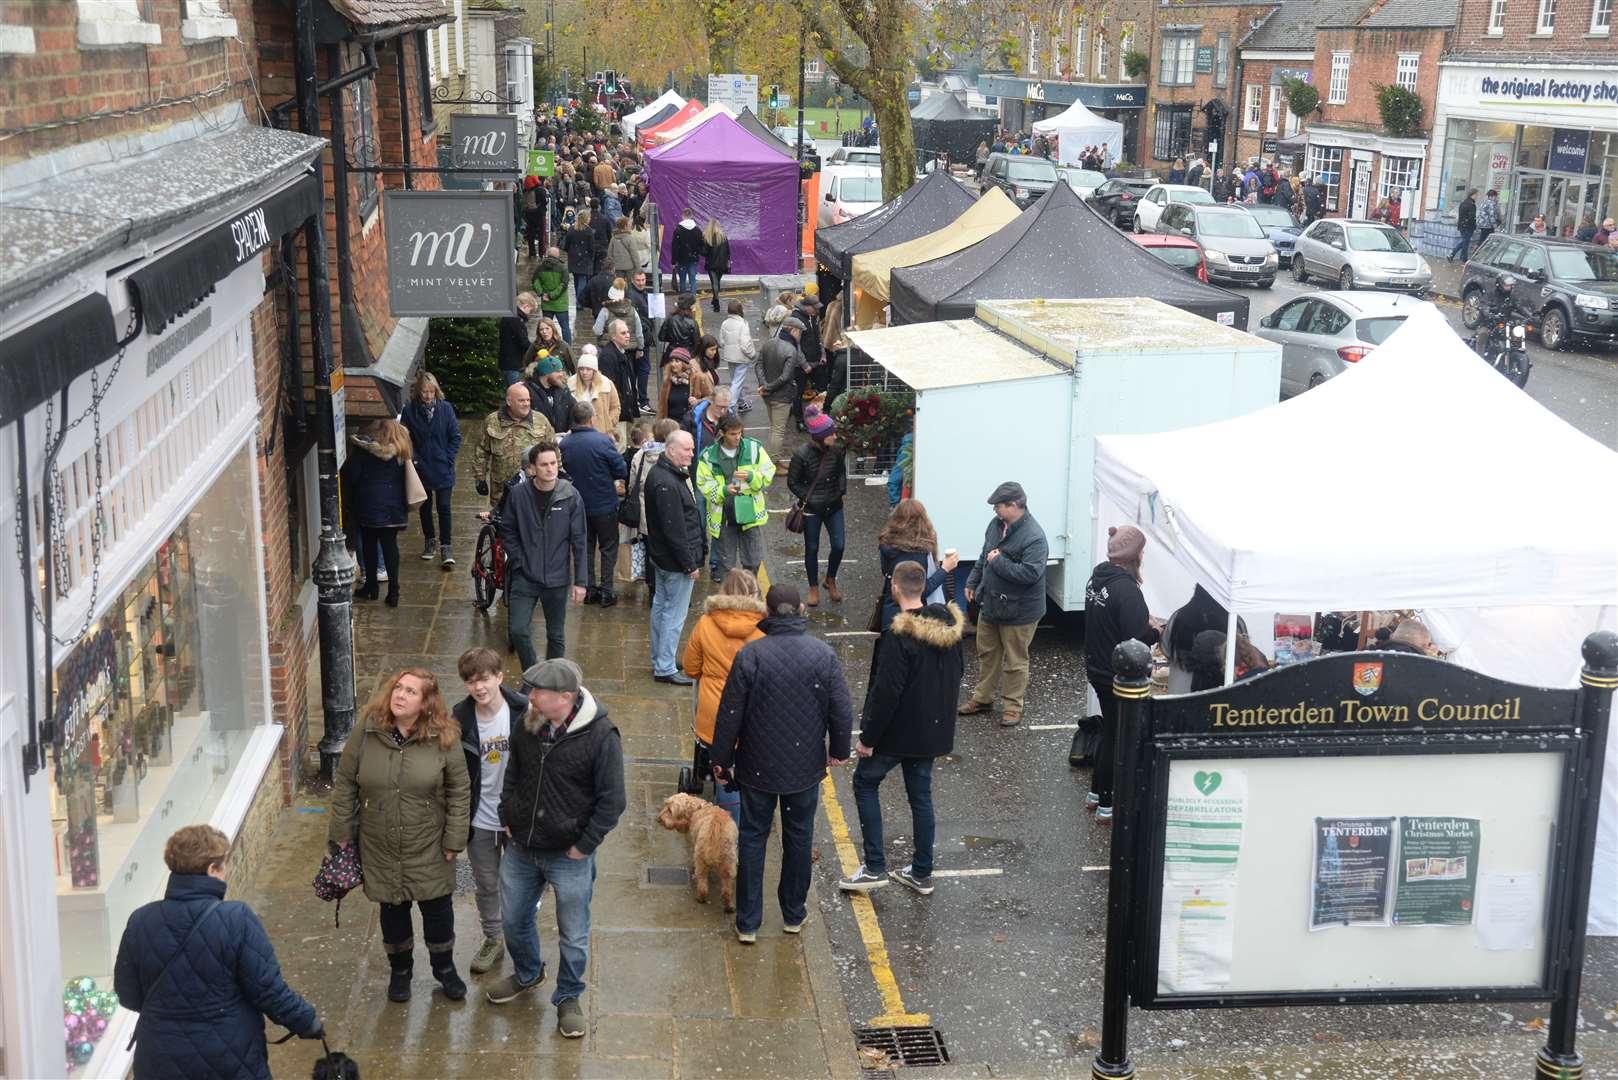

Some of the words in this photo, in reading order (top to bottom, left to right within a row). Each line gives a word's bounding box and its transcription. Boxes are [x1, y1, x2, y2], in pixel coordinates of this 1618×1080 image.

[1481, 76, 1500, 95] the
[1501, 77, 1546, 99] original
[1547, 79, 1592, 102] factory
[1593, 80, 1618, 104] sho
[1556, 144, 1586, 157] welcome
[1491, 160, 1507, 169] off
[410, 278, 442, 287] MINT
[449, 278, 494, 287] VELVET
[1209, 702, 1336, 727] Tenterden
[1340, 700, 1409, 723] Town
[1417, 697, 1521, 722] Council
[1167, 805, 1243, 813] DEFIBRILLATORS
[1408, 819, 1470, 831] Tenterden
[1321, 826, 1388, 837] TENTERDEN
[1404, 830, 1444, 838] Christmas
[1446, 830, 1474, 838] Market
